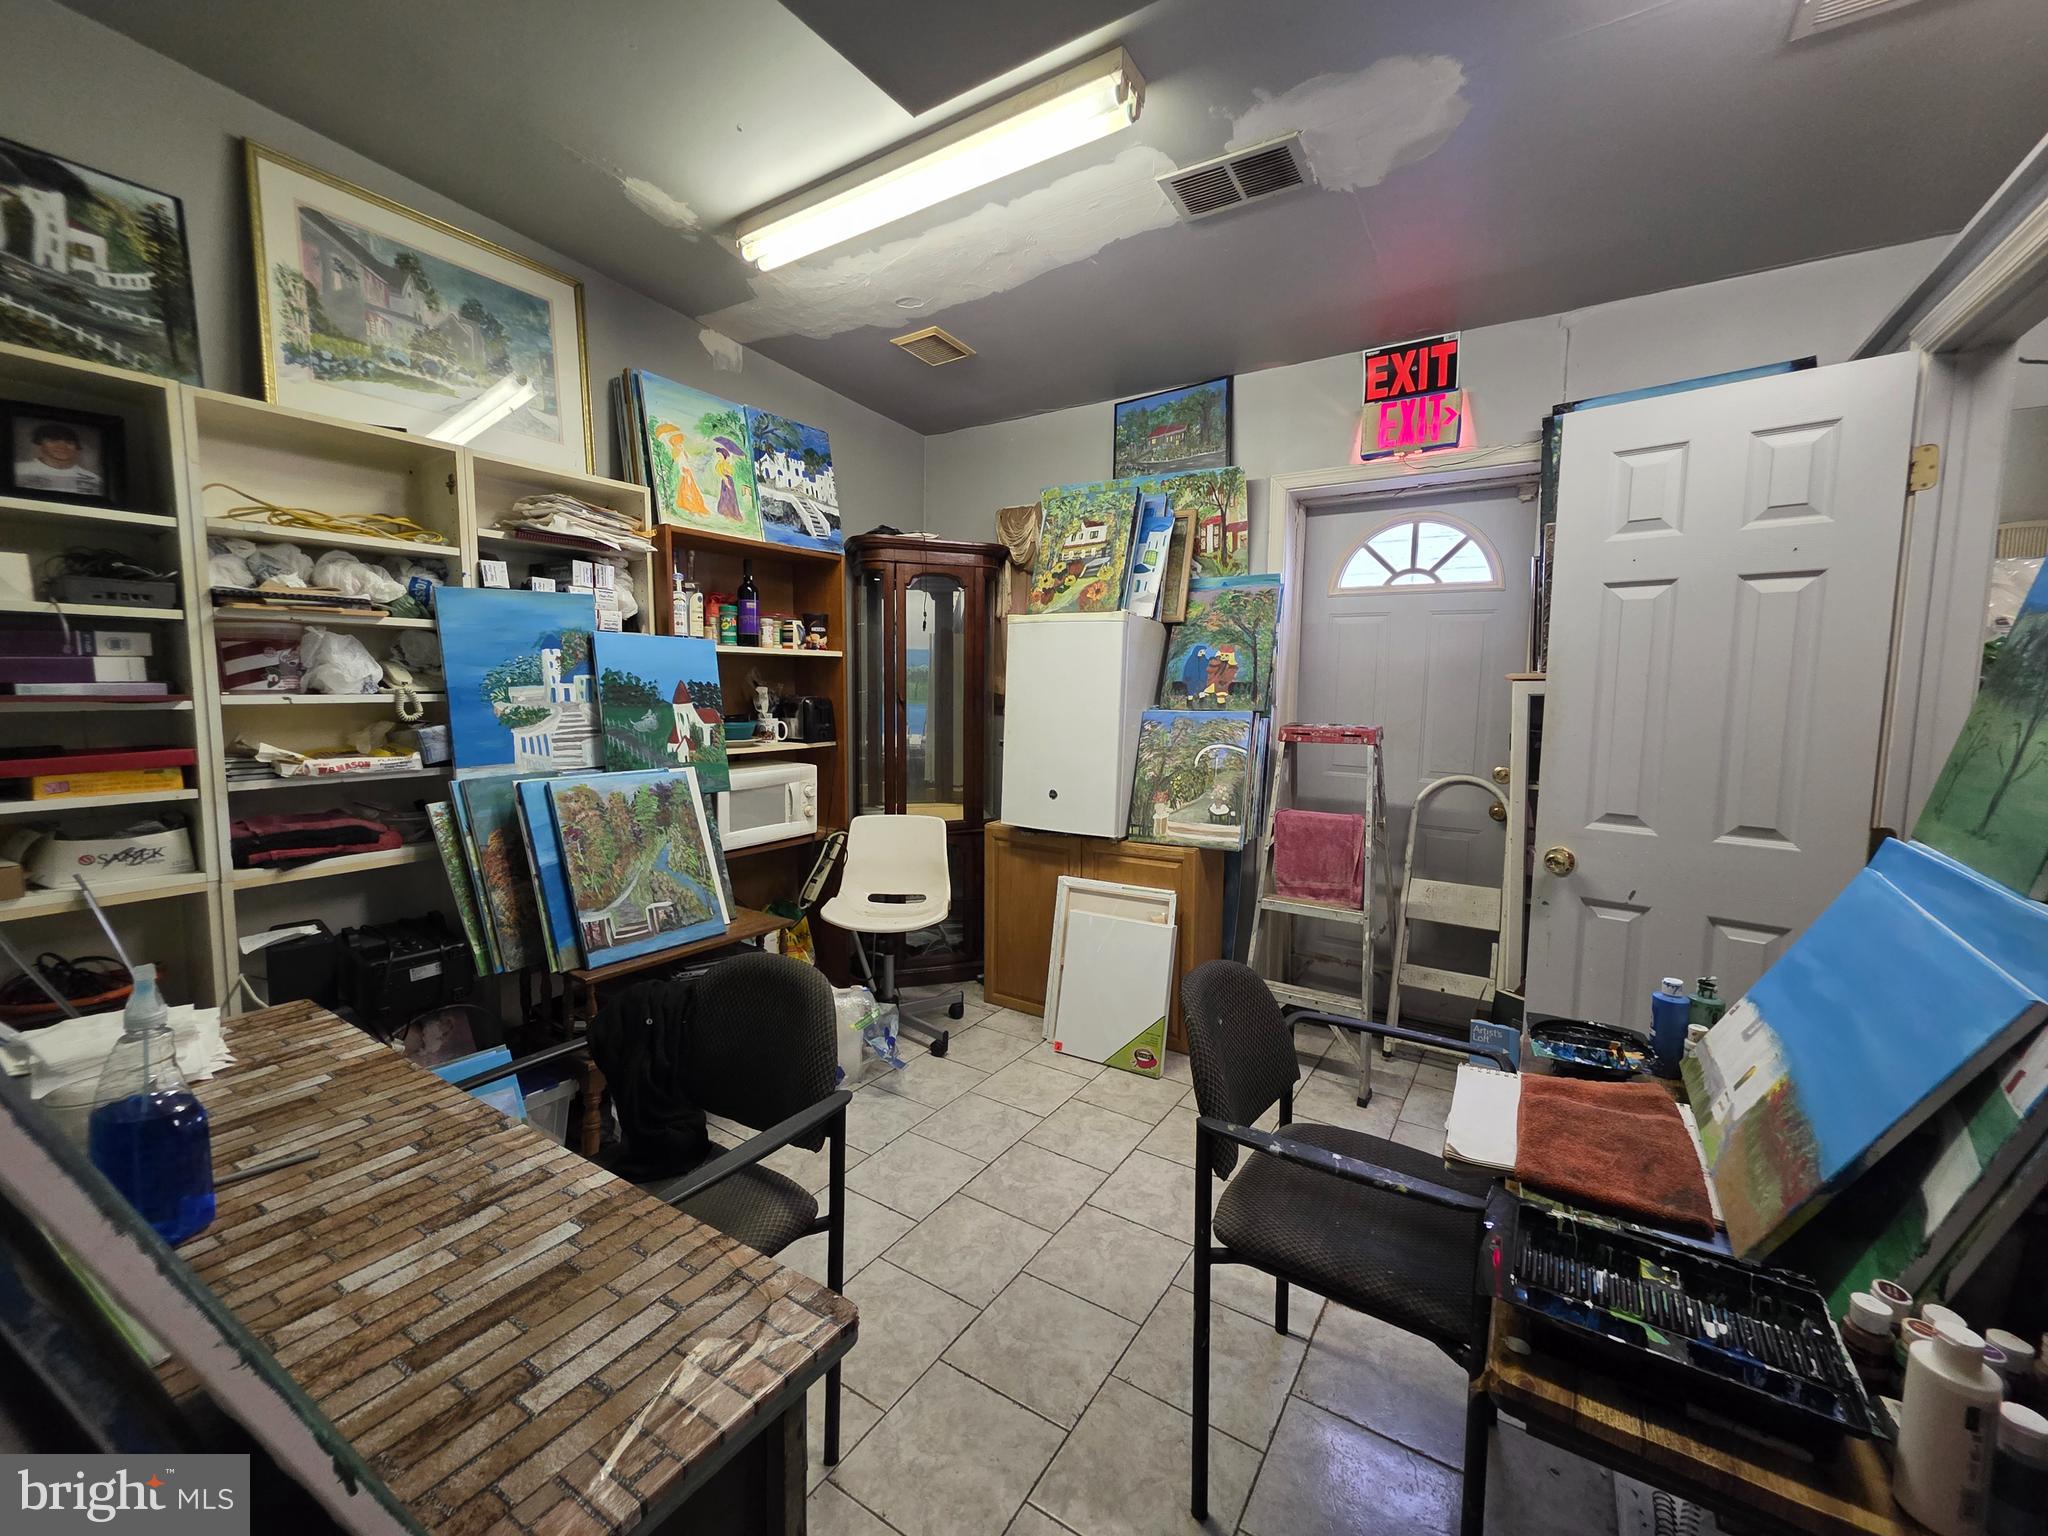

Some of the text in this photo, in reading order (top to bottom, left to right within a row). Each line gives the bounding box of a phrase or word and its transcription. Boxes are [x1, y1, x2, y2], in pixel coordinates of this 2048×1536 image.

[1367, 341, 1456, 400] EXIT
[1378, 393, 1447, 449] EXIT
[1472, 1032, 1490, 1044] Loft
[1473, 1025, 1502, 1038] Artist's
